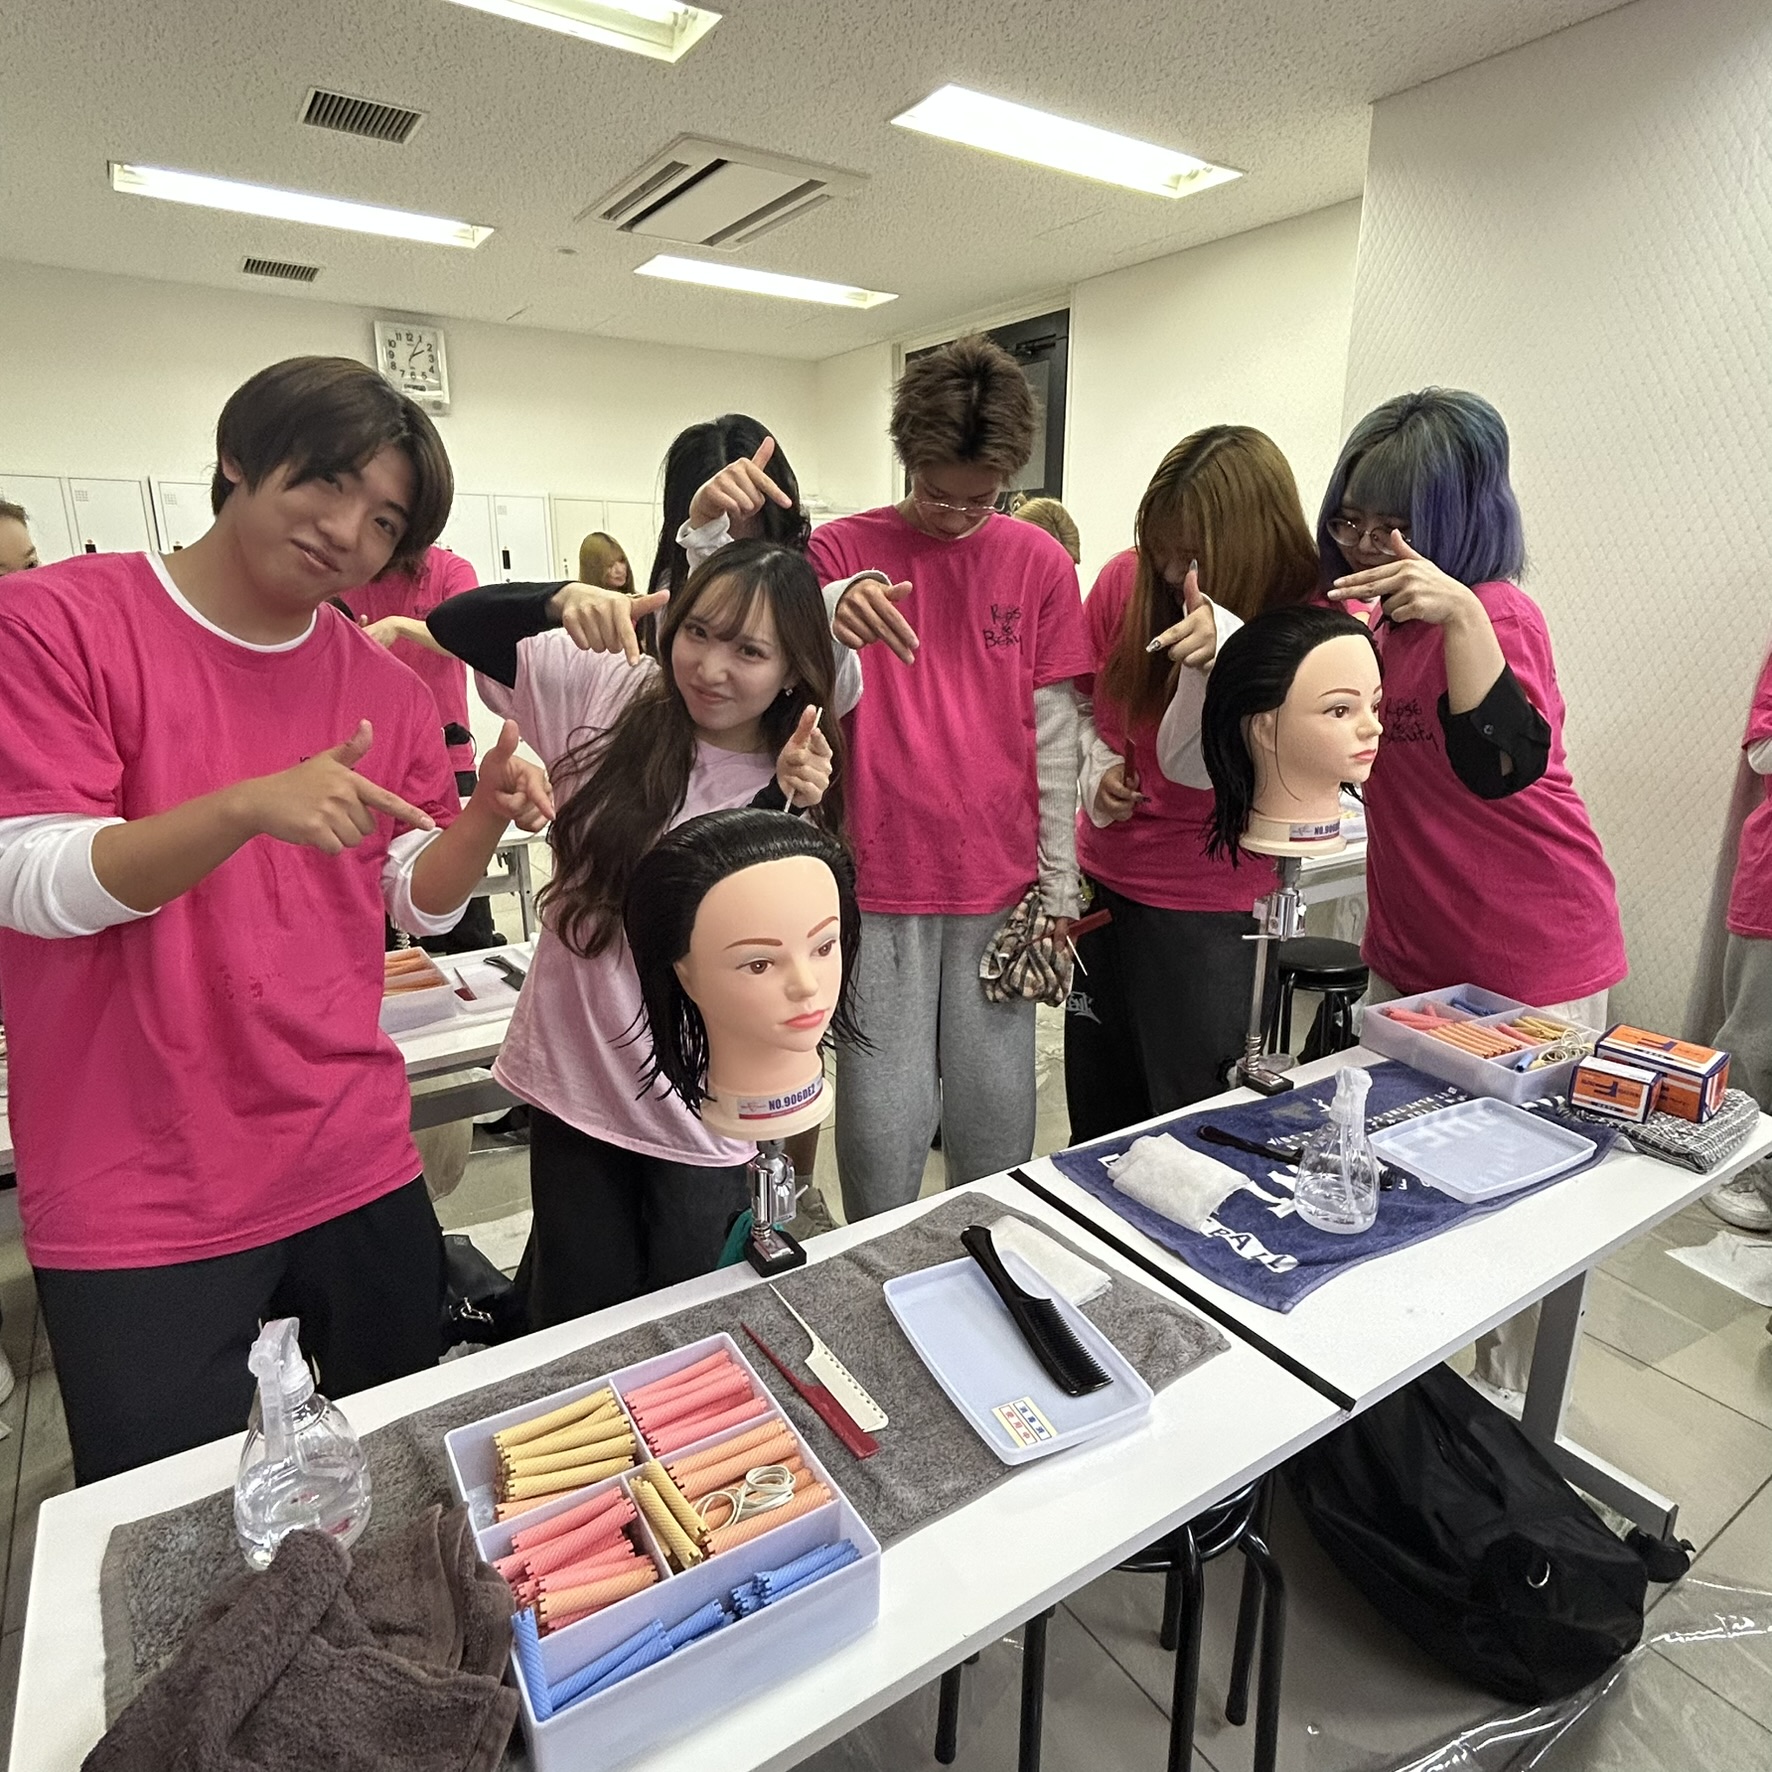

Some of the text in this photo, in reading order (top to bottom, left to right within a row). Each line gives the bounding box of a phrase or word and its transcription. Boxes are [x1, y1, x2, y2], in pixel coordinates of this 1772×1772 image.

[395, 333, 402, 341] 11
[405, 332, 414, 342] 12
[418, 335, 422, 343] 1
[388, 339, 396, 348] 10
[426, 343, 433, 352] 2
[388, 350, 395, 359] 9
[428, 354, 435, 363] 3
[390, 361, 397, 370] 8
[428, 365, 435, 374] 4
[399, 369, 405, 378] 7
[410, 371, 416, 380] 6
[421, 371, 428, 380] 5
